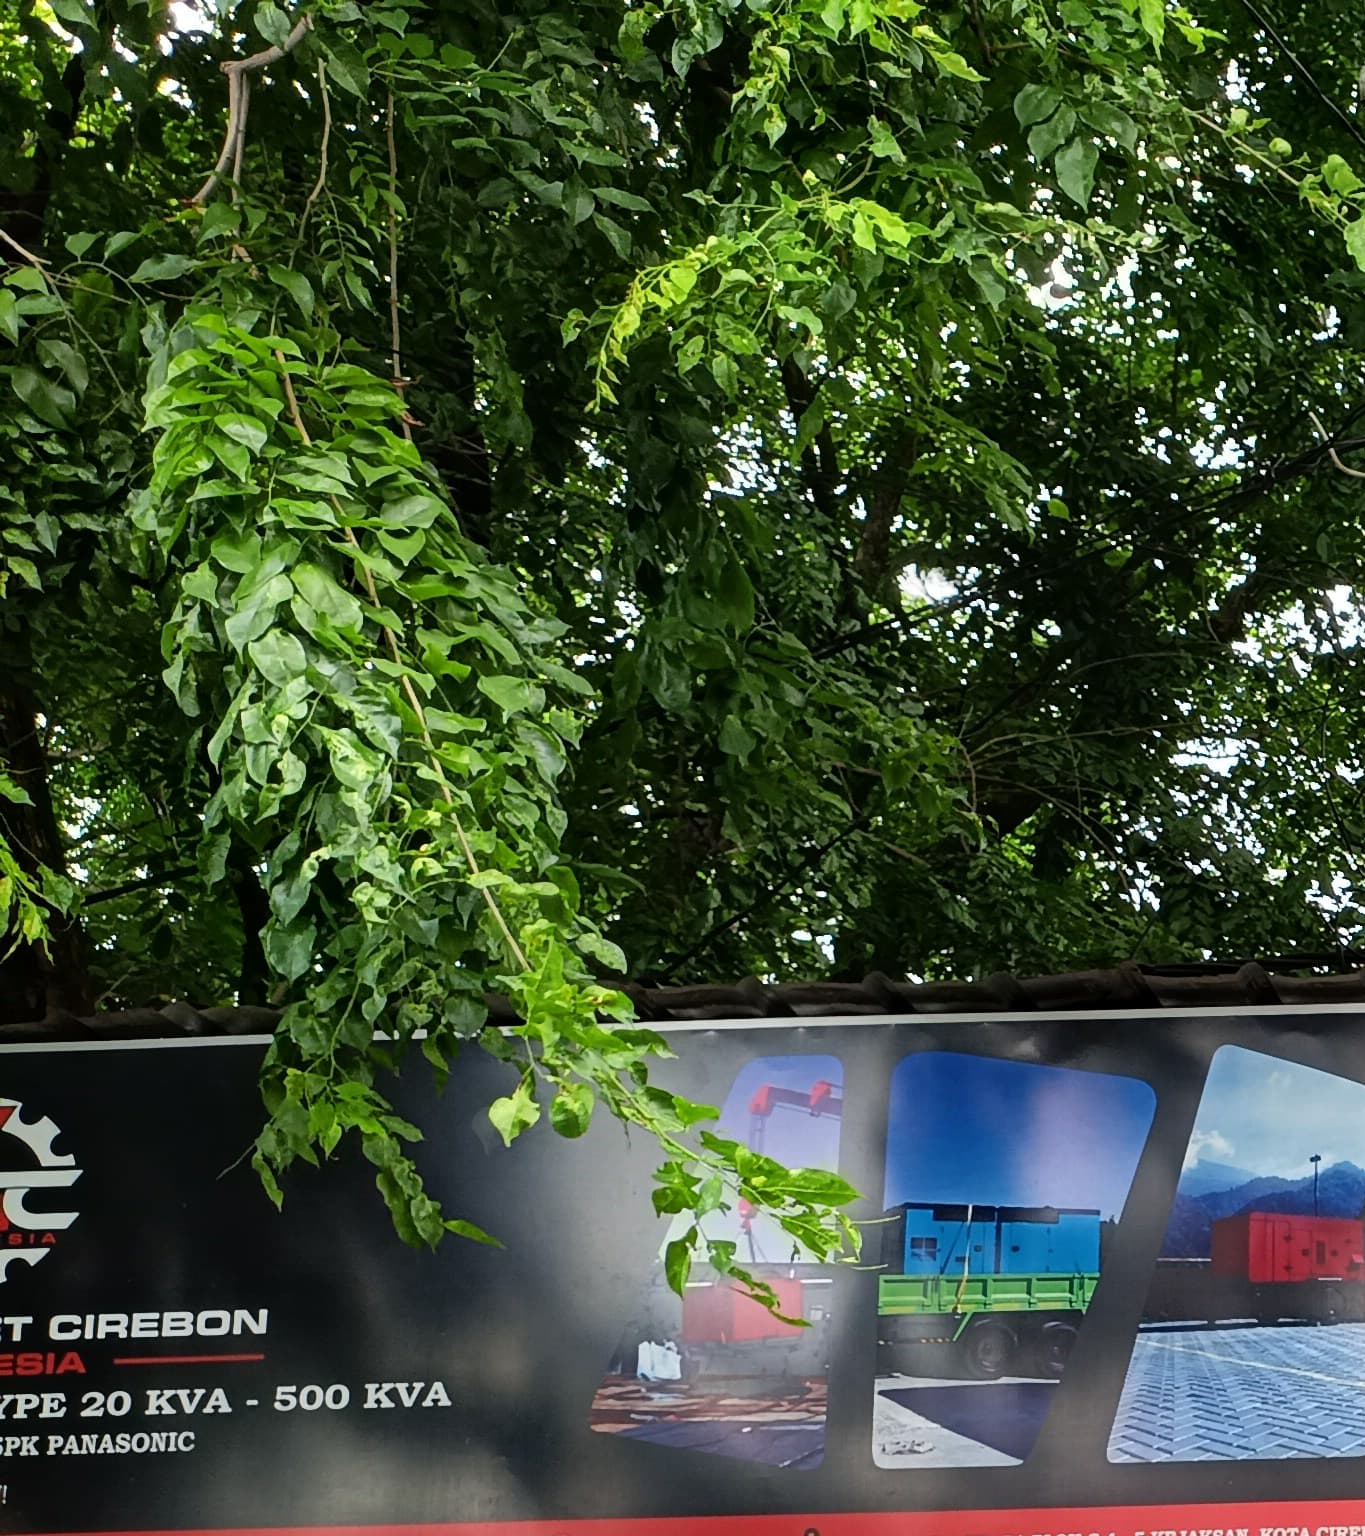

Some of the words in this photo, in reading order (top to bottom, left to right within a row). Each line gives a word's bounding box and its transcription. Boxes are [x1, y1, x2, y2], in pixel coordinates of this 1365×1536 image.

[0, 1316, 34, 1341] T
[49, 1309, 268, 1341] CIREBON
[80, 1391, 132, 1418] 20
[144, 1388, 232, 1415] KVA
[273, 1384, 350, 1412] 500
[363, 1381, 452, 1409] KVA
[46, 1431, 195, 1456] PANASONIC
